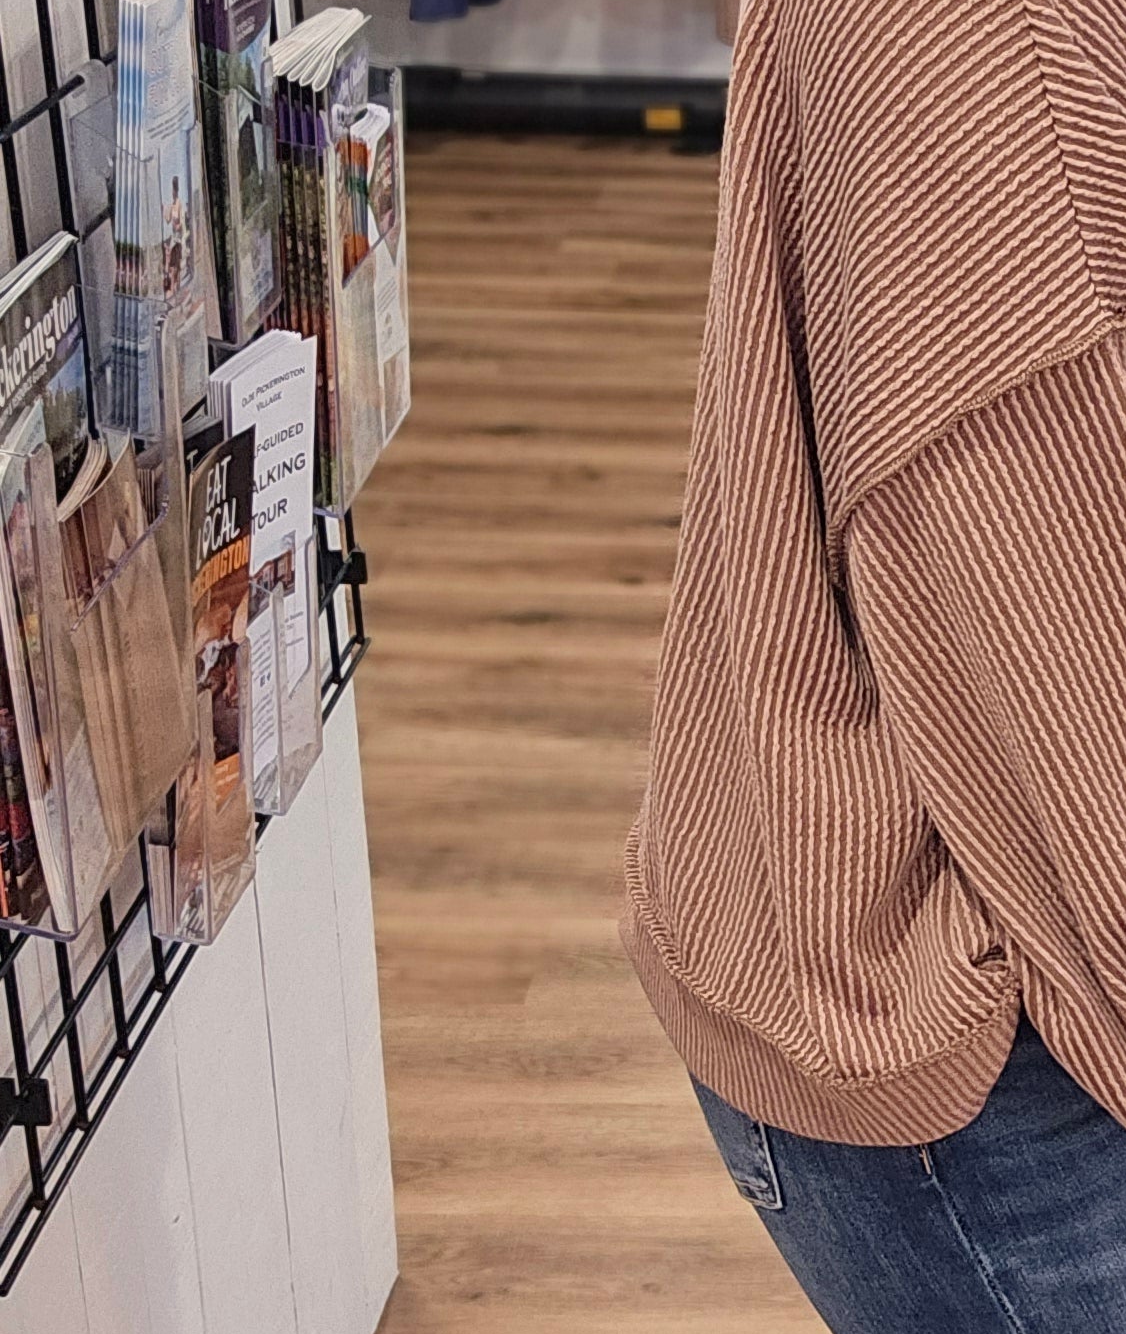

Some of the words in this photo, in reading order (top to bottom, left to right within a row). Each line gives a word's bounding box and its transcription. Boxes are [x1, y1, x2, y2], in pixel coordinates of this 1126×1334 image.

[254, 422, 304, 459] F-GUIDED
[206, 455, 232, 514] EAT
[251, 452, 306, 495] ALKING
[196, 497, 241, 571] LOCAL
